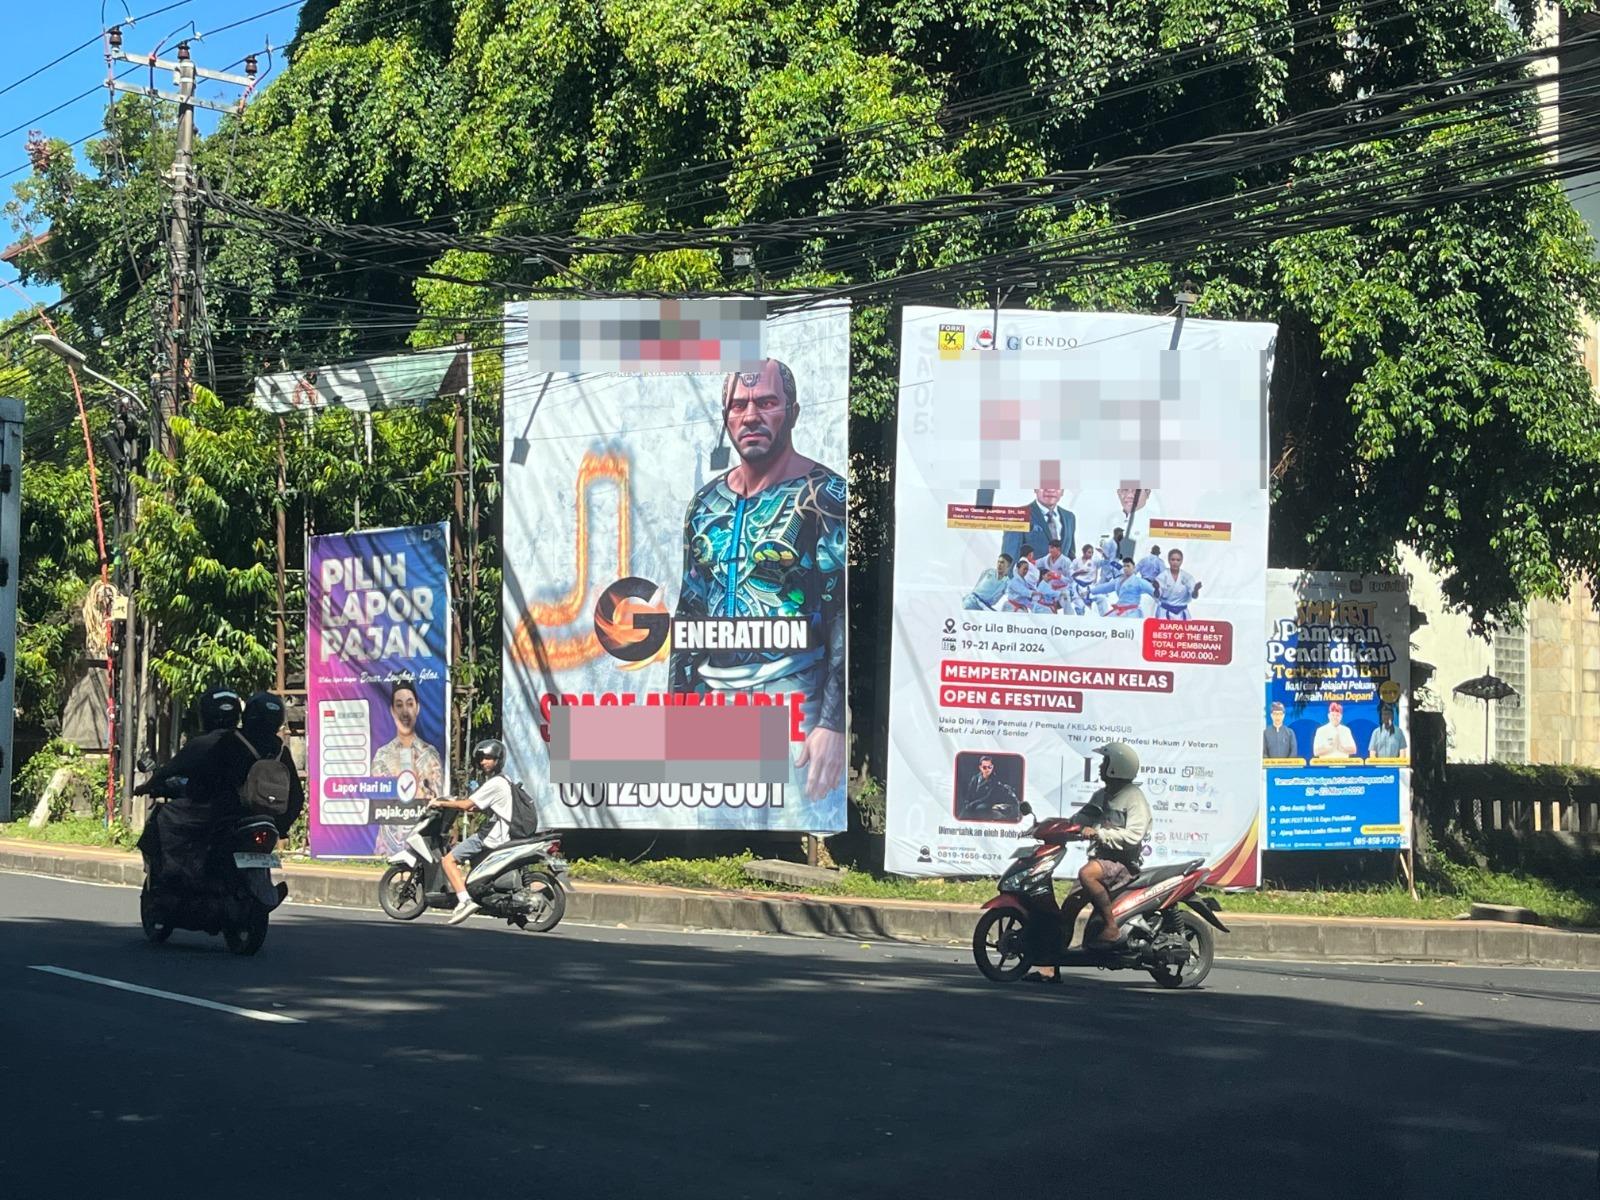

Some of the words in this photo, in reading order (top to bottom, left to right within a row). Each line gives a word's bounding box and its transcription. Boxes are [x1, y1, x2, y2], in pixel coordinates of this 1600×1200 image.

[1025, 335, 1078, 348] GENDO
[321, 552, 407, 593] PILIH
[321, 587, 434, 627] LAPOR
[962, 622, 982, 632] Gor
[985, 623, 1003, 633] Lila
[1006, 624, 1048, 635] Bhuana
[1050, 625, 1107, 639] (Denpasar,
[1111, 628, 1135, 640] Bali)
[1158, 623, 1184, 631] JUARA
[1184, 624, 1208, 632] UMUM
[1280, 620, 1380, 642] Pameran
[320, 622, 432, 663] PAJAK
[1152, 631, 1172, 639] BEST
[1173, 632, 1185, 640] OF
[1186, 633, 1202, 641] THE
[1202, 634, 1223, 642] BEST
[962, 639, 988, 650] 19-21
[991, 641, 1017, 653] April
[1020, 642, 1045, 653] 2024
[1152, 640, 1175, 649] TOTAL
[1176, 641, 1221, 650] PEMBINAAN
[1267, 641, 1395, 662] Pendidikan
[1154, 649, 1167, 658] RP
[944, 665, 1115, 686] MEMPERTANDINGKAN
[1118, 672, 1169, 689] KELAS
[1273, 664, 1340, 678] Terbesar
[1341, 664, 1358, 678] Di
[1360, 664, 1388, 678] Bali
[1319, 681, 1348, 692] Jelajahi
[1348, 681, 1378, 692] Peluang
[943, 689, 987, 705] OPEN
[990, 691, 1001, 705] &
[1004, 692, 1076, 709] FESTIVAL
[1323, 692, 1344, 701] Masa
[1345, 691, 1374, 702] Depan!
[938, 717, 956, 725] Usia
[959, 717, 974, 725] Dini
[982, 718, 995, 726] Pra
[997, 719, 1027, 728] Pemula
[1035, 721, 1065, 730] Pemula
[1071, 724, 1097, 732] KELAS
[1099, 725, 1133, 733] KHUSUS
[969, 728, 995, 736] Junior
[1002, 729, 1028, 737] Senior
[1068, 734, 1082, 742] TNI
[1089, 735, 1114, 743] POLRI
[1122, 737, 1150, 746] Profesi
[1152, 739, 1180, 747] Hukum
[1187, 740, 1218, 749] Veteran
[1140, 766, 1156, 774] BPD
[1158, 766, 1176, 775] BALI
[332, 782, 358, 794] Lapor
[359, 781, 378, 793] Hari
[380, 781, 392, 792] Ini
